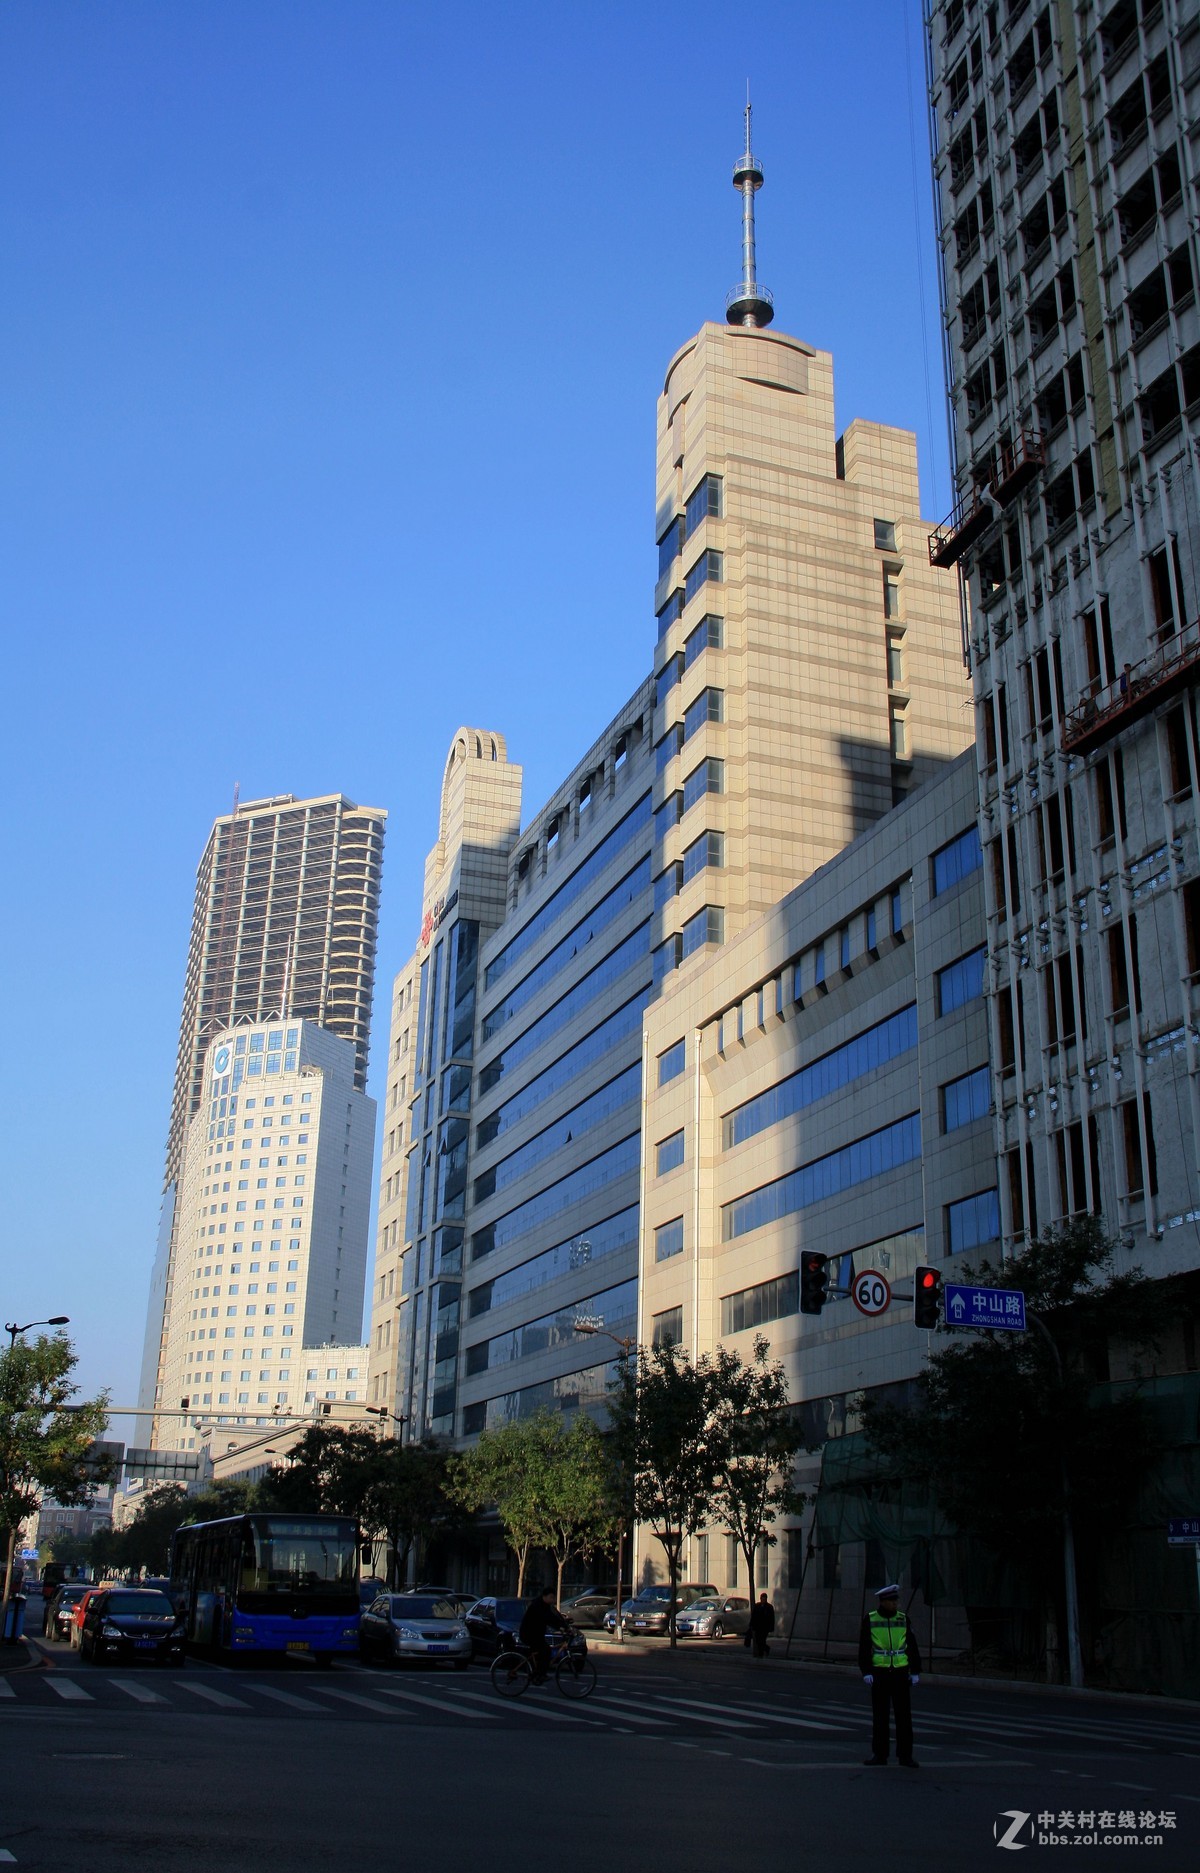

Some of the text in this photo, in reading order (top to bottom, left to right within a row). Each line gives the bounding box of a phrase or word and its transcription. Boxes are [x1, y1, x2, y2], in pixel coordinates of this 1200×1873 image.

[858, 1280, 885, 1307] 60
[972, 1291, 1021, 1316] 中山路
[971, 1314, 1023, 1326] ZHONGSHAN ROAD
[1182, 1521, 1200, 1533] 中山
